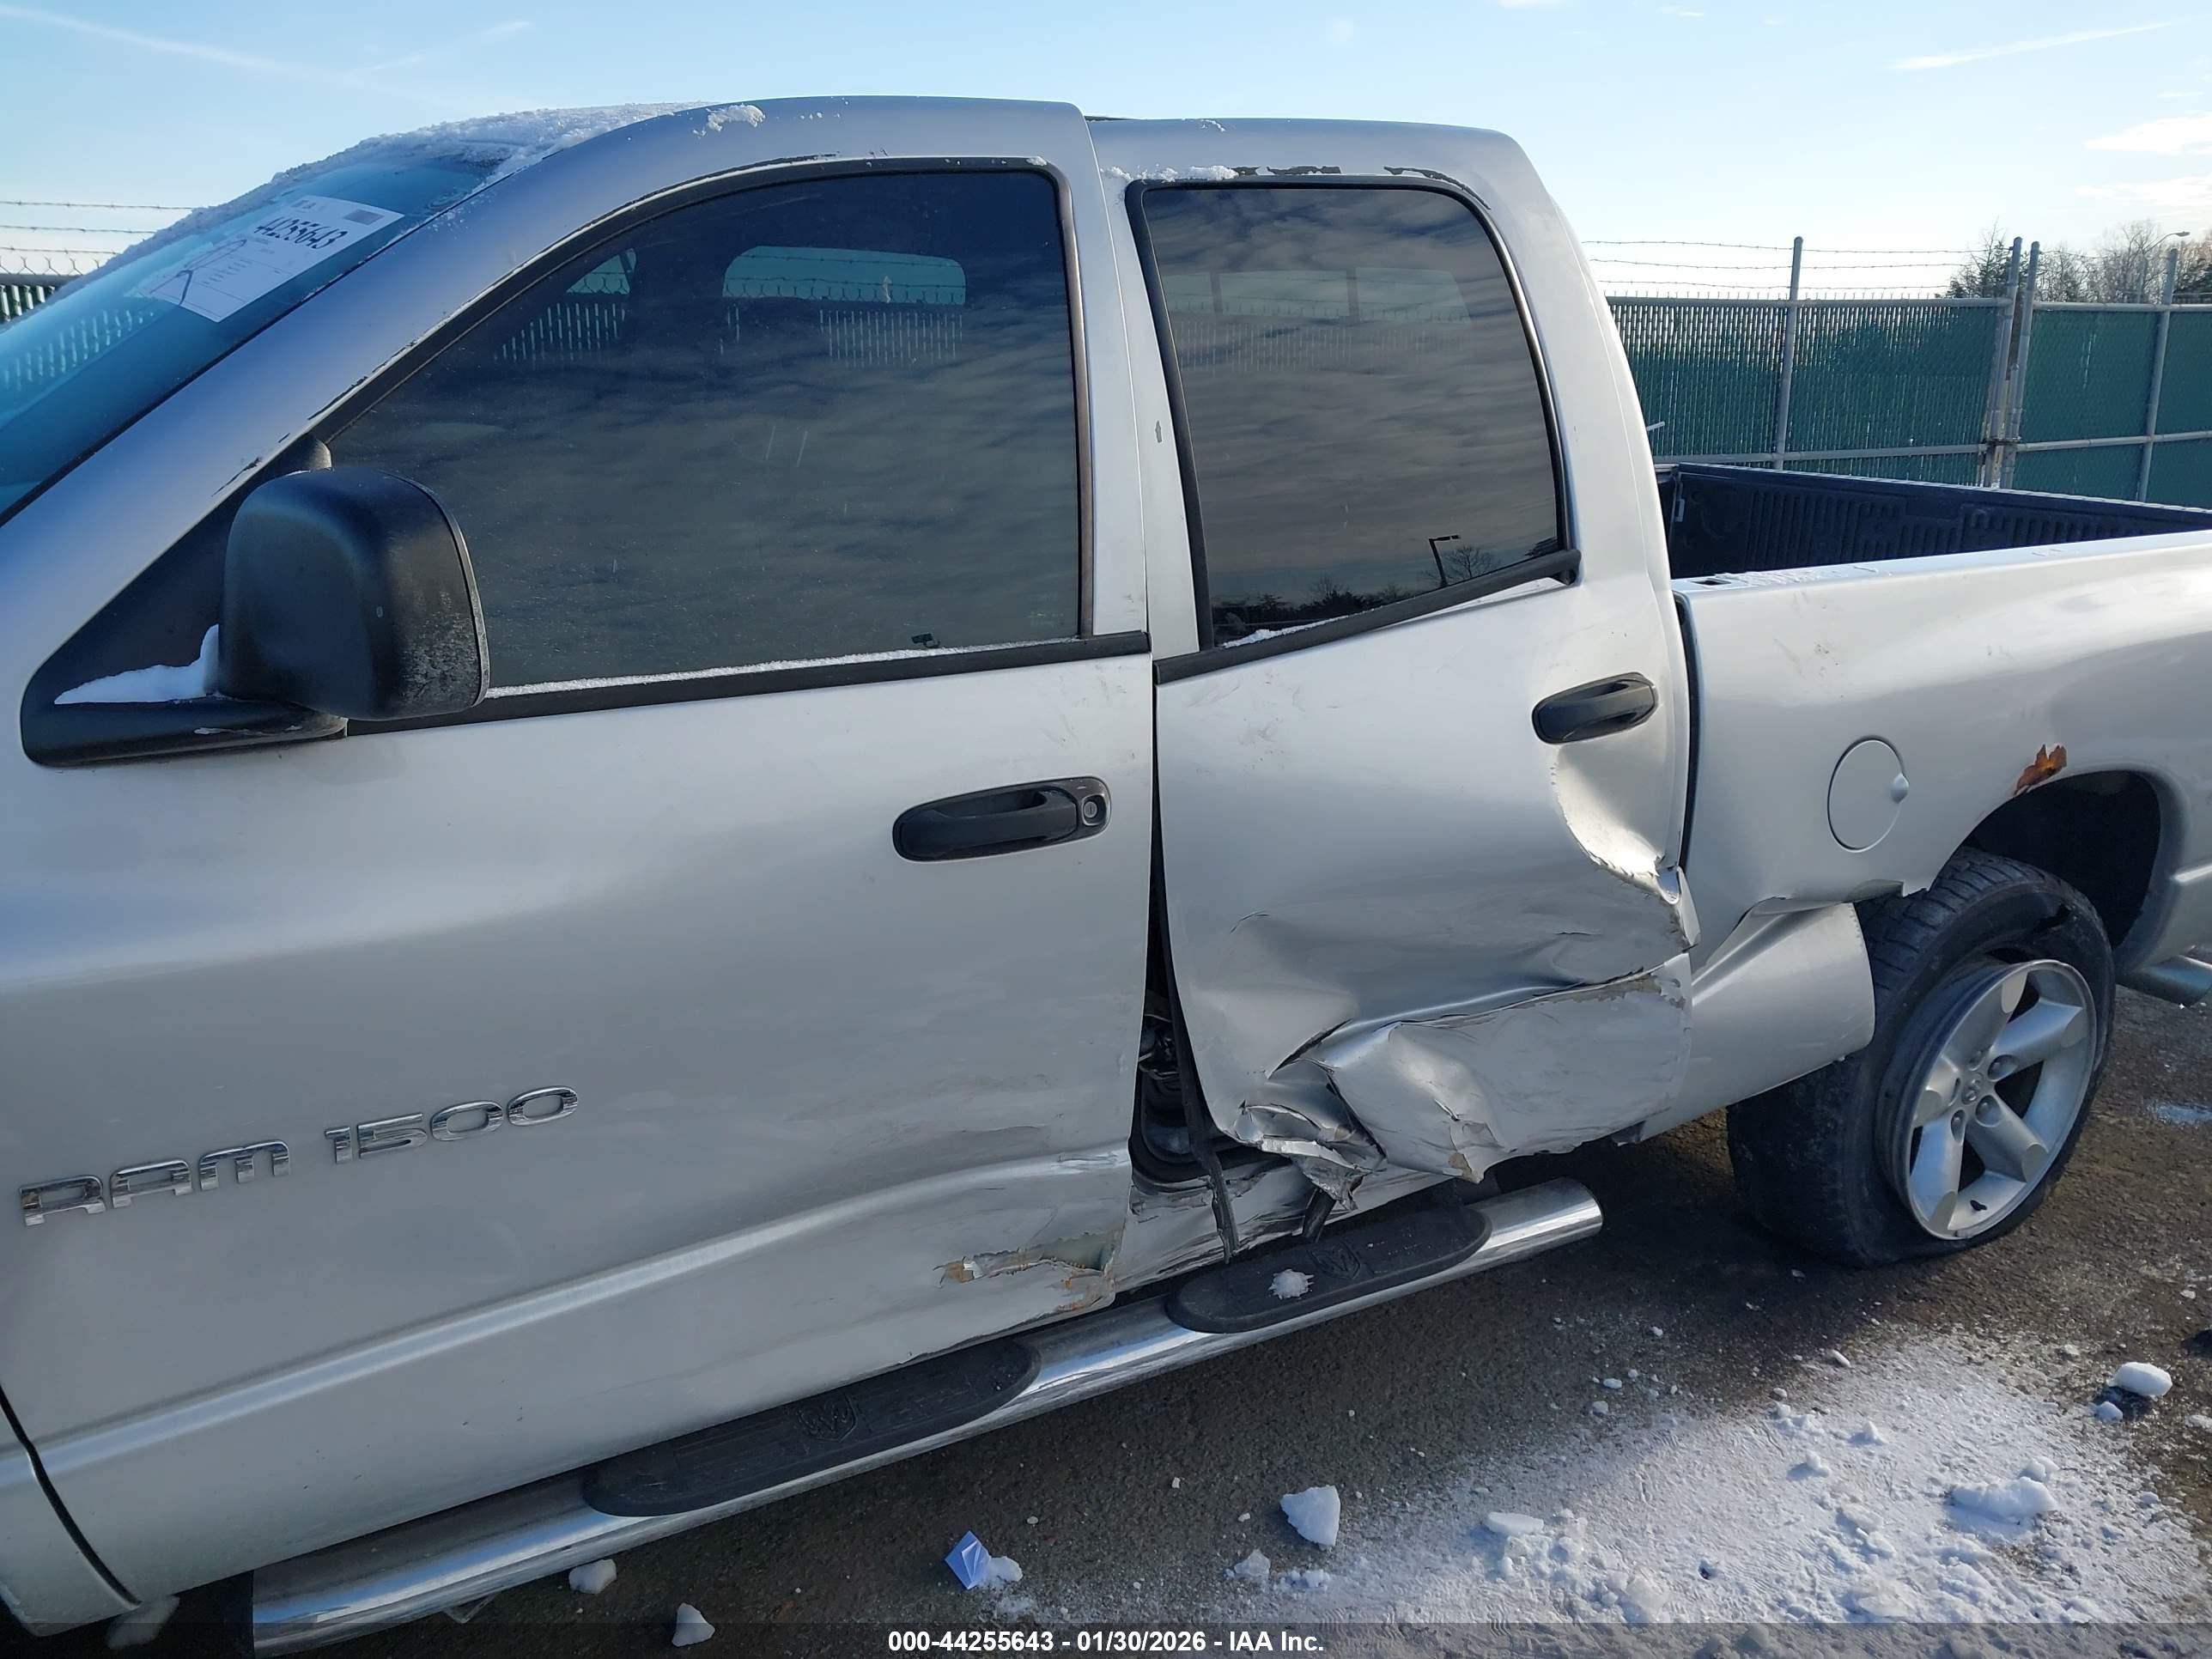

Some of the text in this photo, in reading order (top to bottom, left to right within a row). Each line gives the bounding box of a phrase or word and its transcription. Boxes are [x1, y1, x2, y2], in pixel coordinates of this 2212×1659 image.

[254, 216, 348, 249] 44255643
[20, 1085, 579, 1226] RAM 1500
